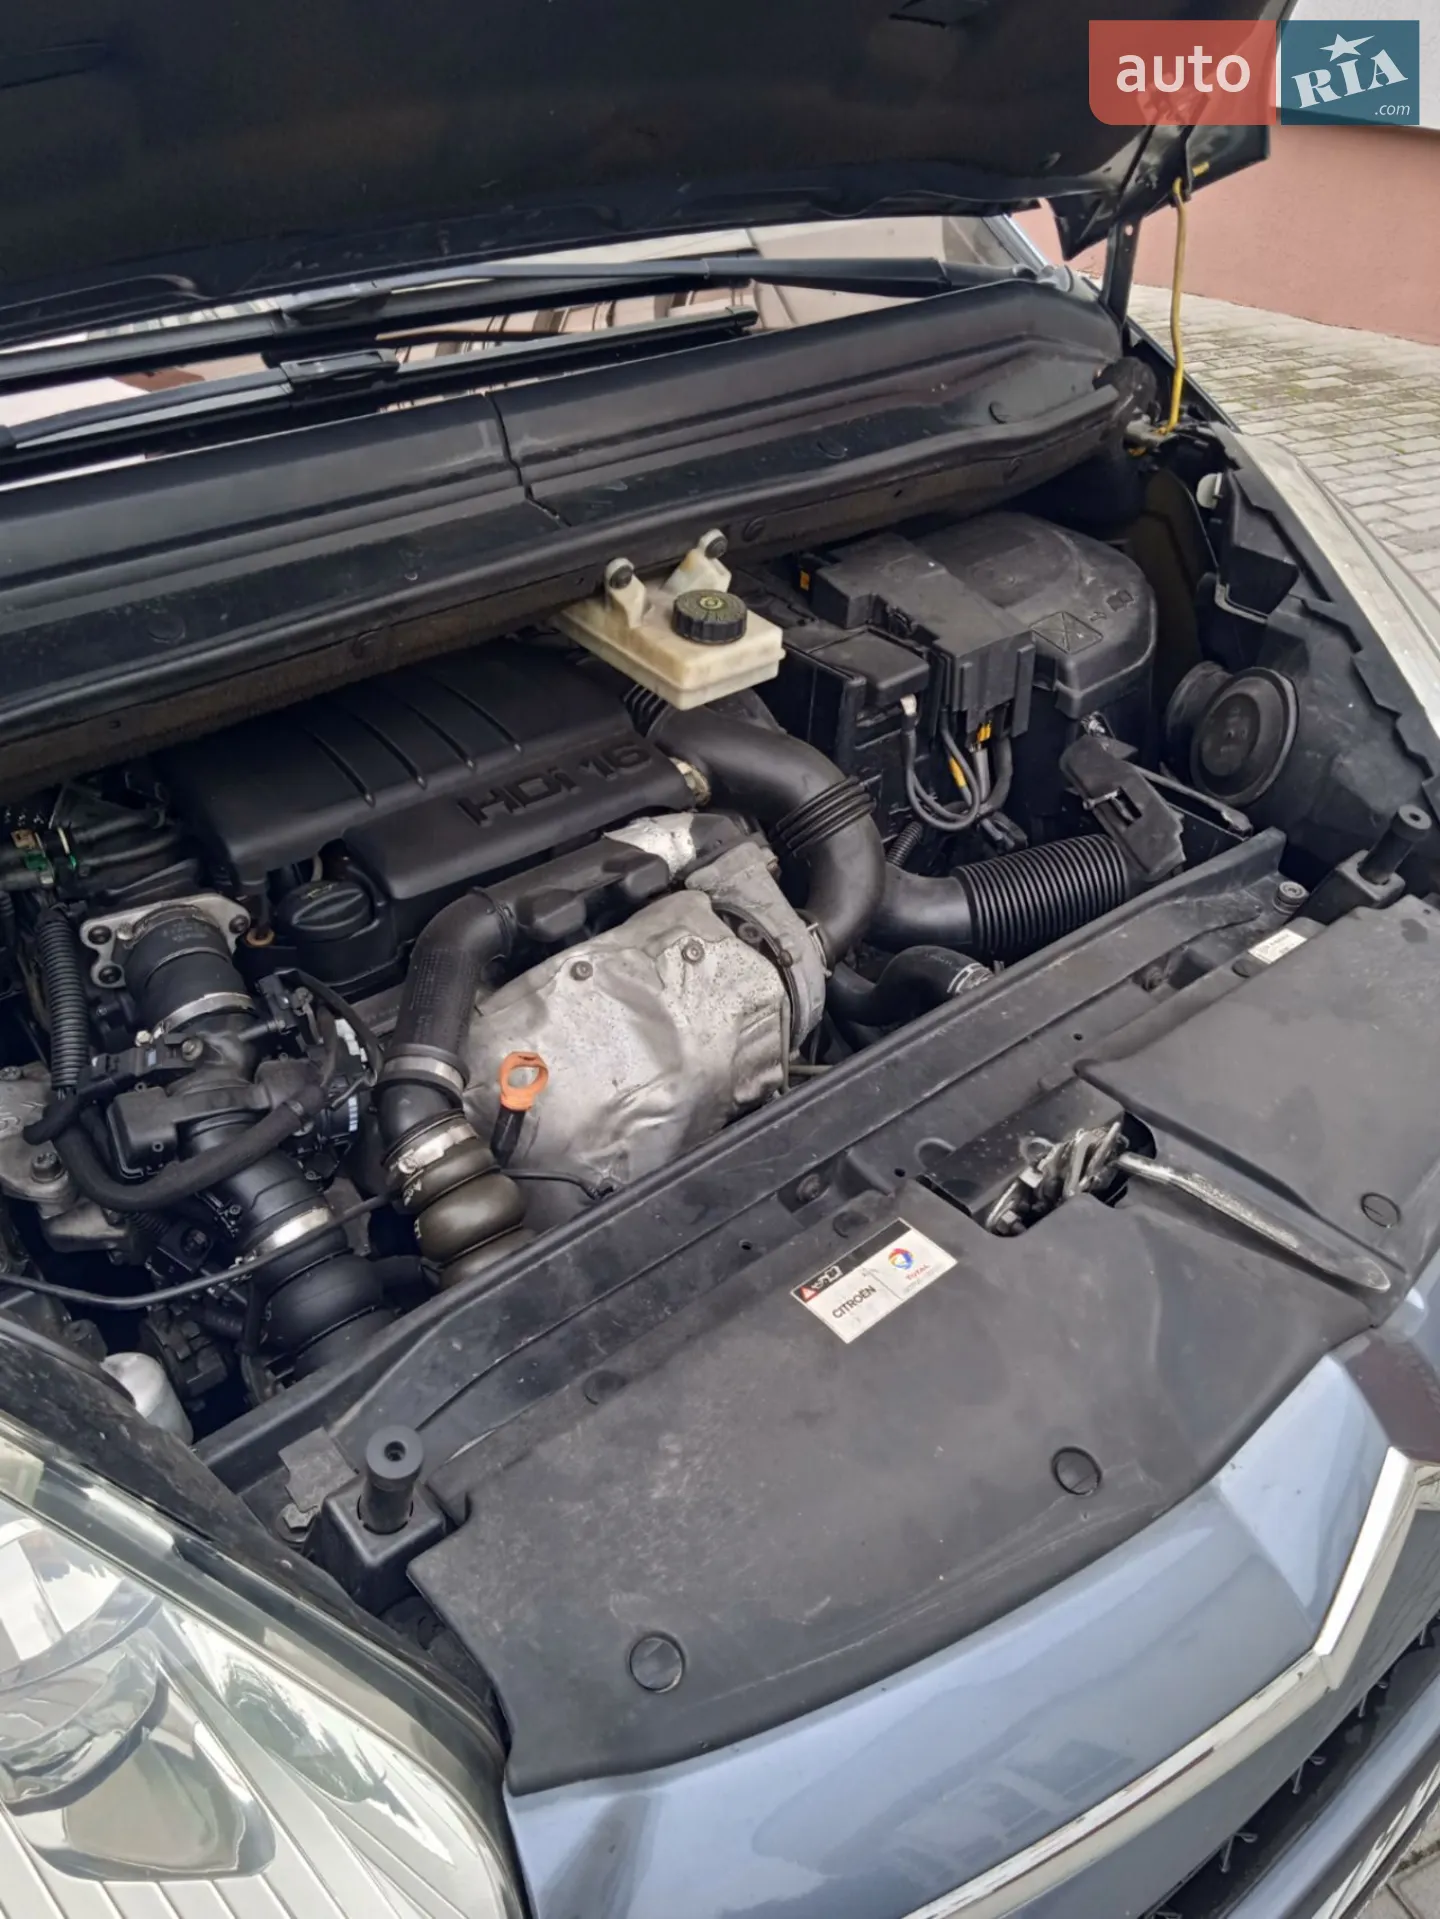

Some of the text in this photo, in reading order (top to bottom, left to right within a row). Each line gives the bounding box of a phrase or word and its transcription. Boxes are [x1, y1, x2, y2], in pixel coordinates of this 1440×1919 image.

[579, 746, 652, 781] 16
[906, 1264, 931, 1281] TOTAL
[832, 1285, 877, 1319] CITROËN
